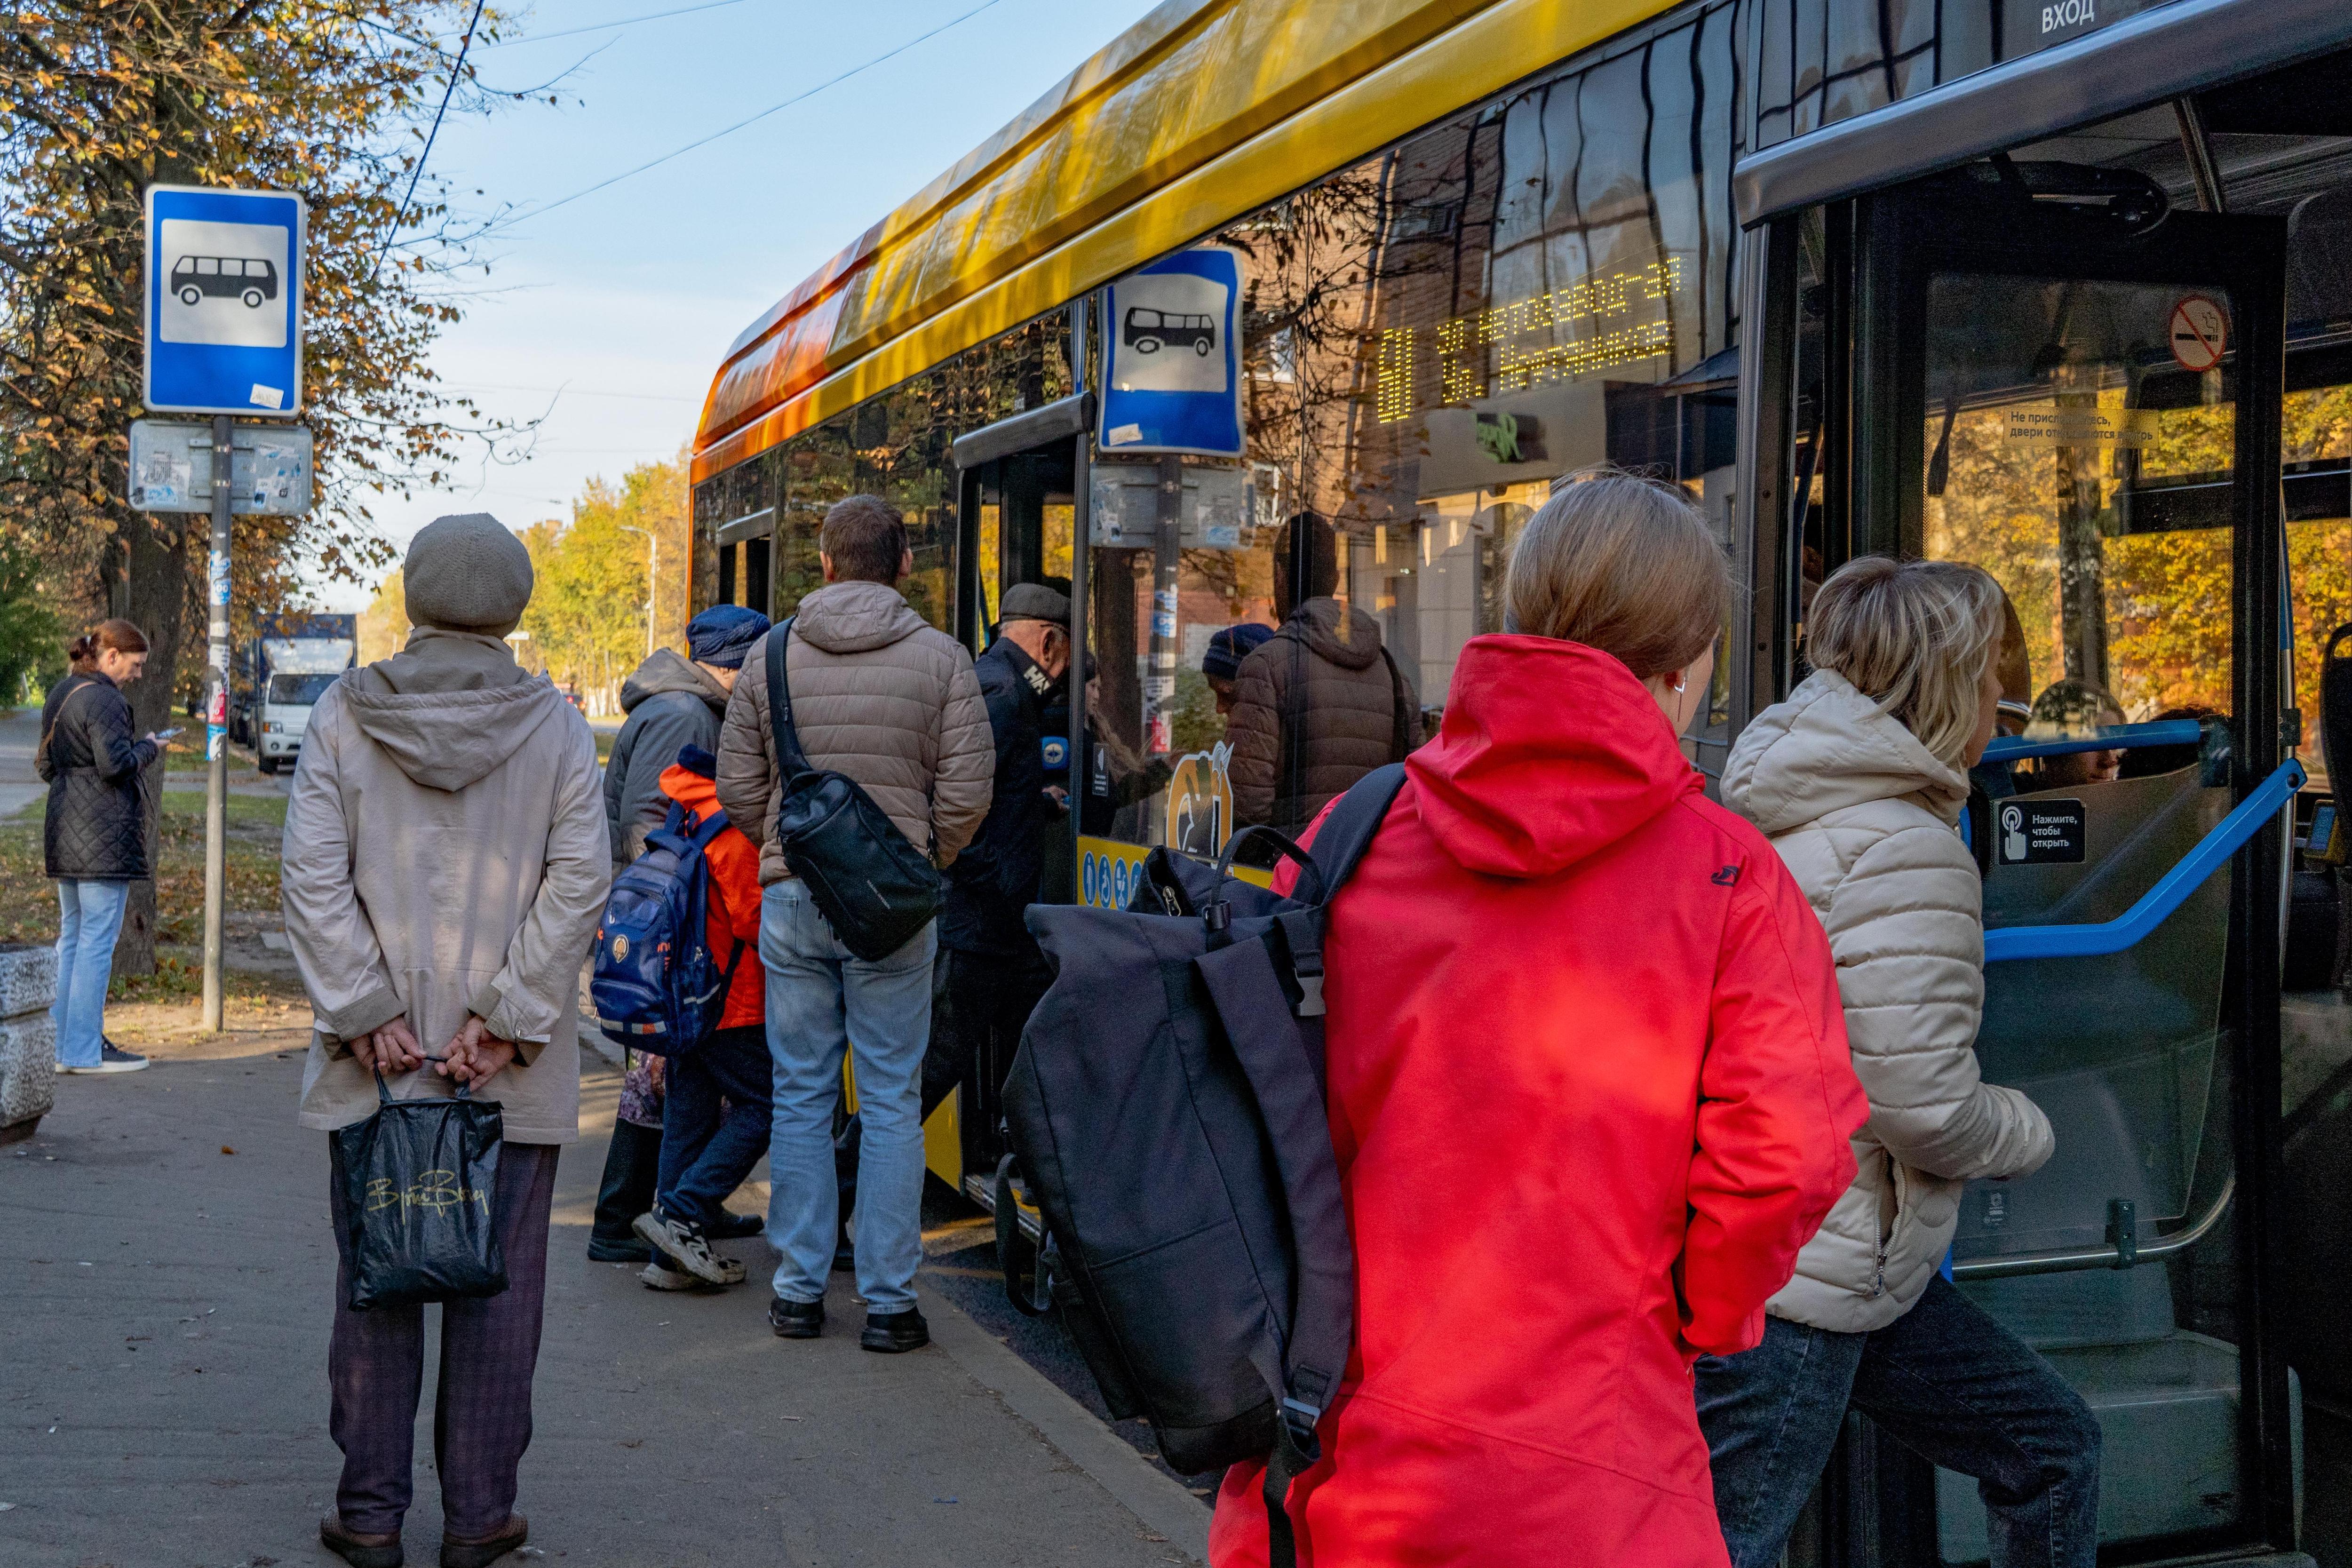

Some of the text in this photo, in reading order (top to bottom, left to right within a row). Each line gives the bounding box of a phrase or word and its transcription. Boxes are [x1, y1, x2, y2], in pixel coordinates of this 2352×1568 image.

[2042, 0, 2094, 33] ВХОД
[2010, 412, 2026, 422] Не
[2010, 427, 2043, 439] двери
[2032, 814, 2078, 825] Нажмите,
[2032, 826, 2061, 836] чтобы
[2032, 839, 2069, 849] открыть
